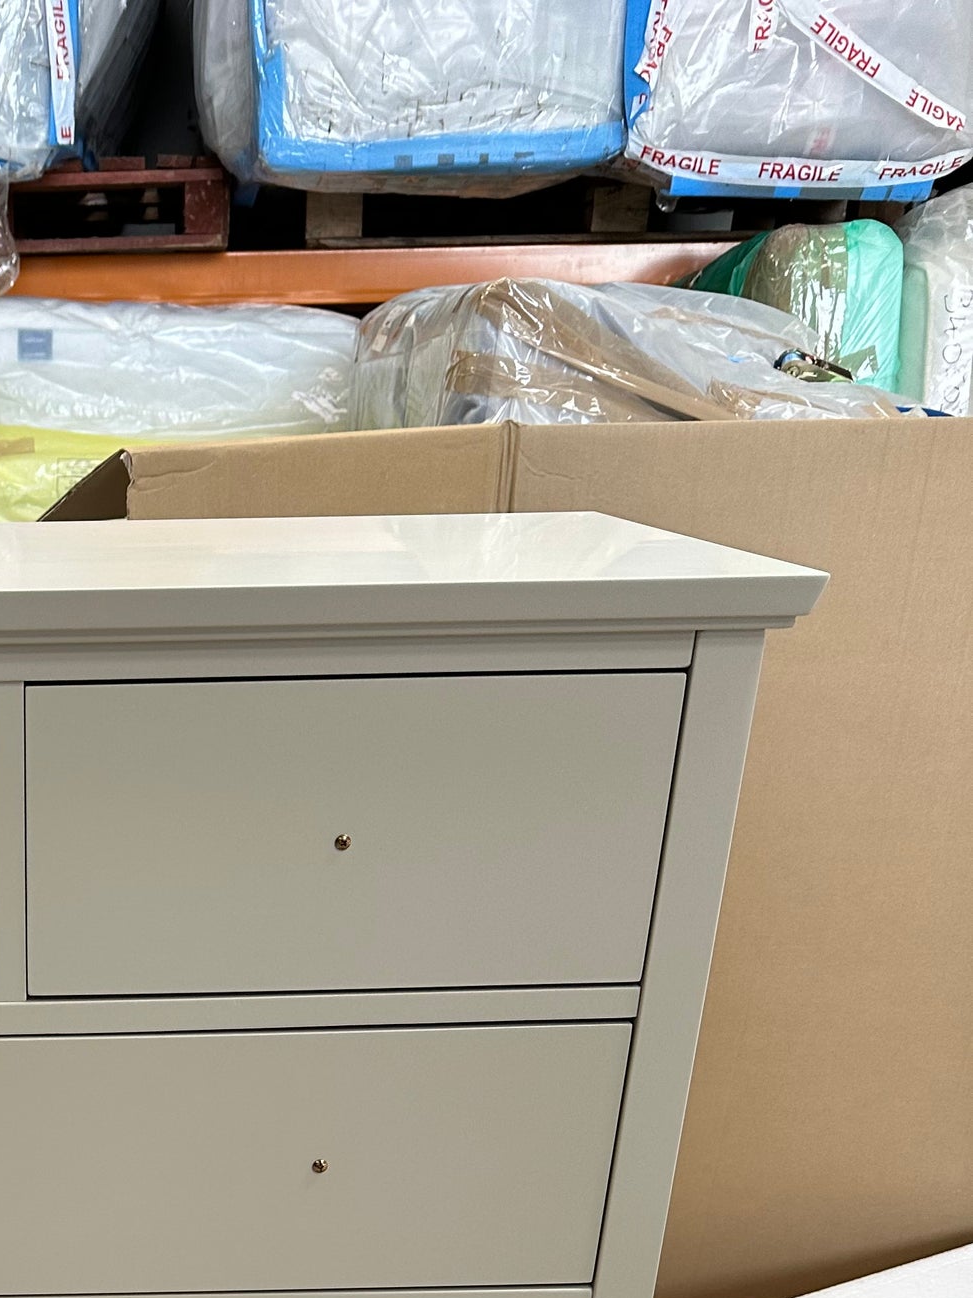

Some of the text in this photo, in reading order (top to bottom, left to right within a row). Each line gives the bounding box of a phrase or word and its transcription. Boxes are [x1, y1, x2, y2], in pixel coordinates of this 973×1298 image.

[810, 14, 881, 78] FRAGILE
[640, 145, 721, 176] FRAGILE
[758, 161, 843, 182] FRAGILE
[878, 155, 964, 180] FRAGILE
